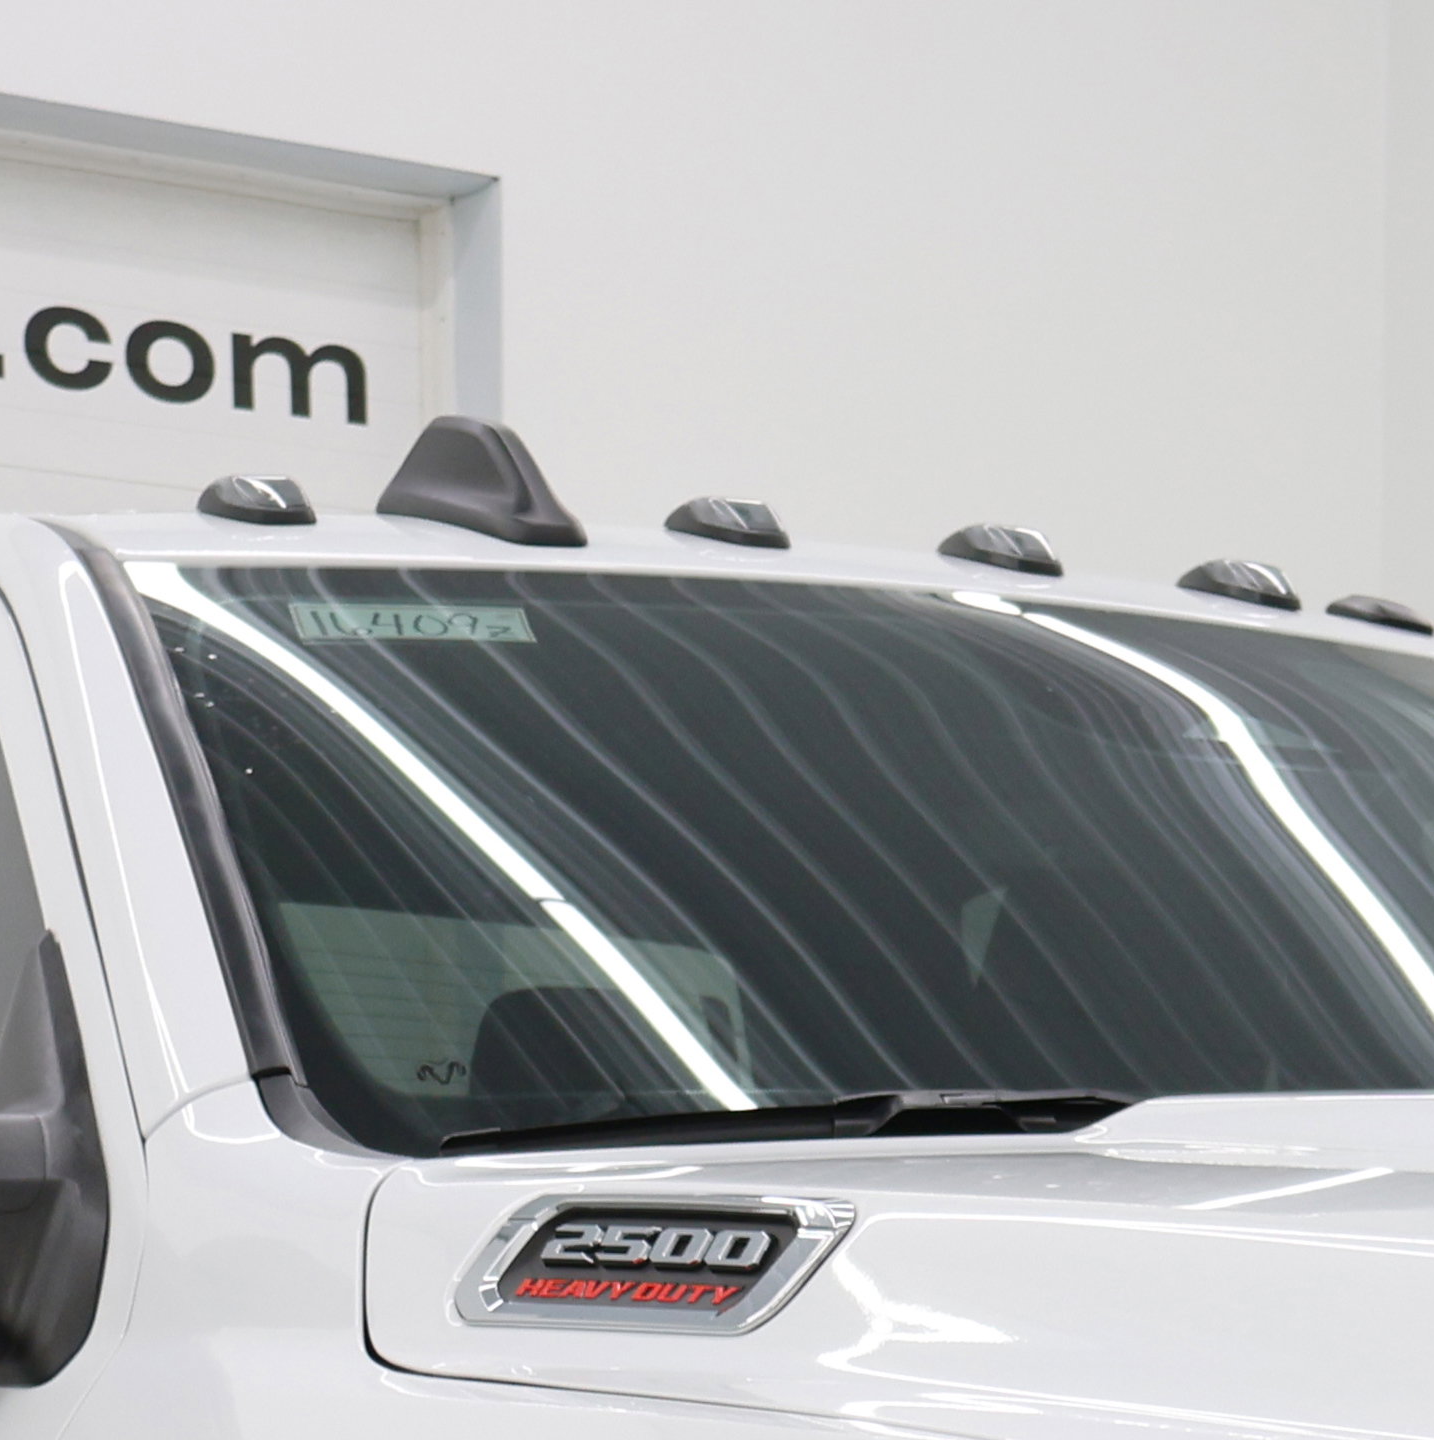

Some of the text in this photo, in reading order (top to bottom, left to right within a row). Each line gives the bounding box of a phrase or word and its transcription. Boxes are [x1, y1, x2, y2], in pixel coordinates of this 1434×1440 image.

[541, 1224, 771, 1272] 2500
[516, 1279, 740, 1305] HEAVY DUTY
